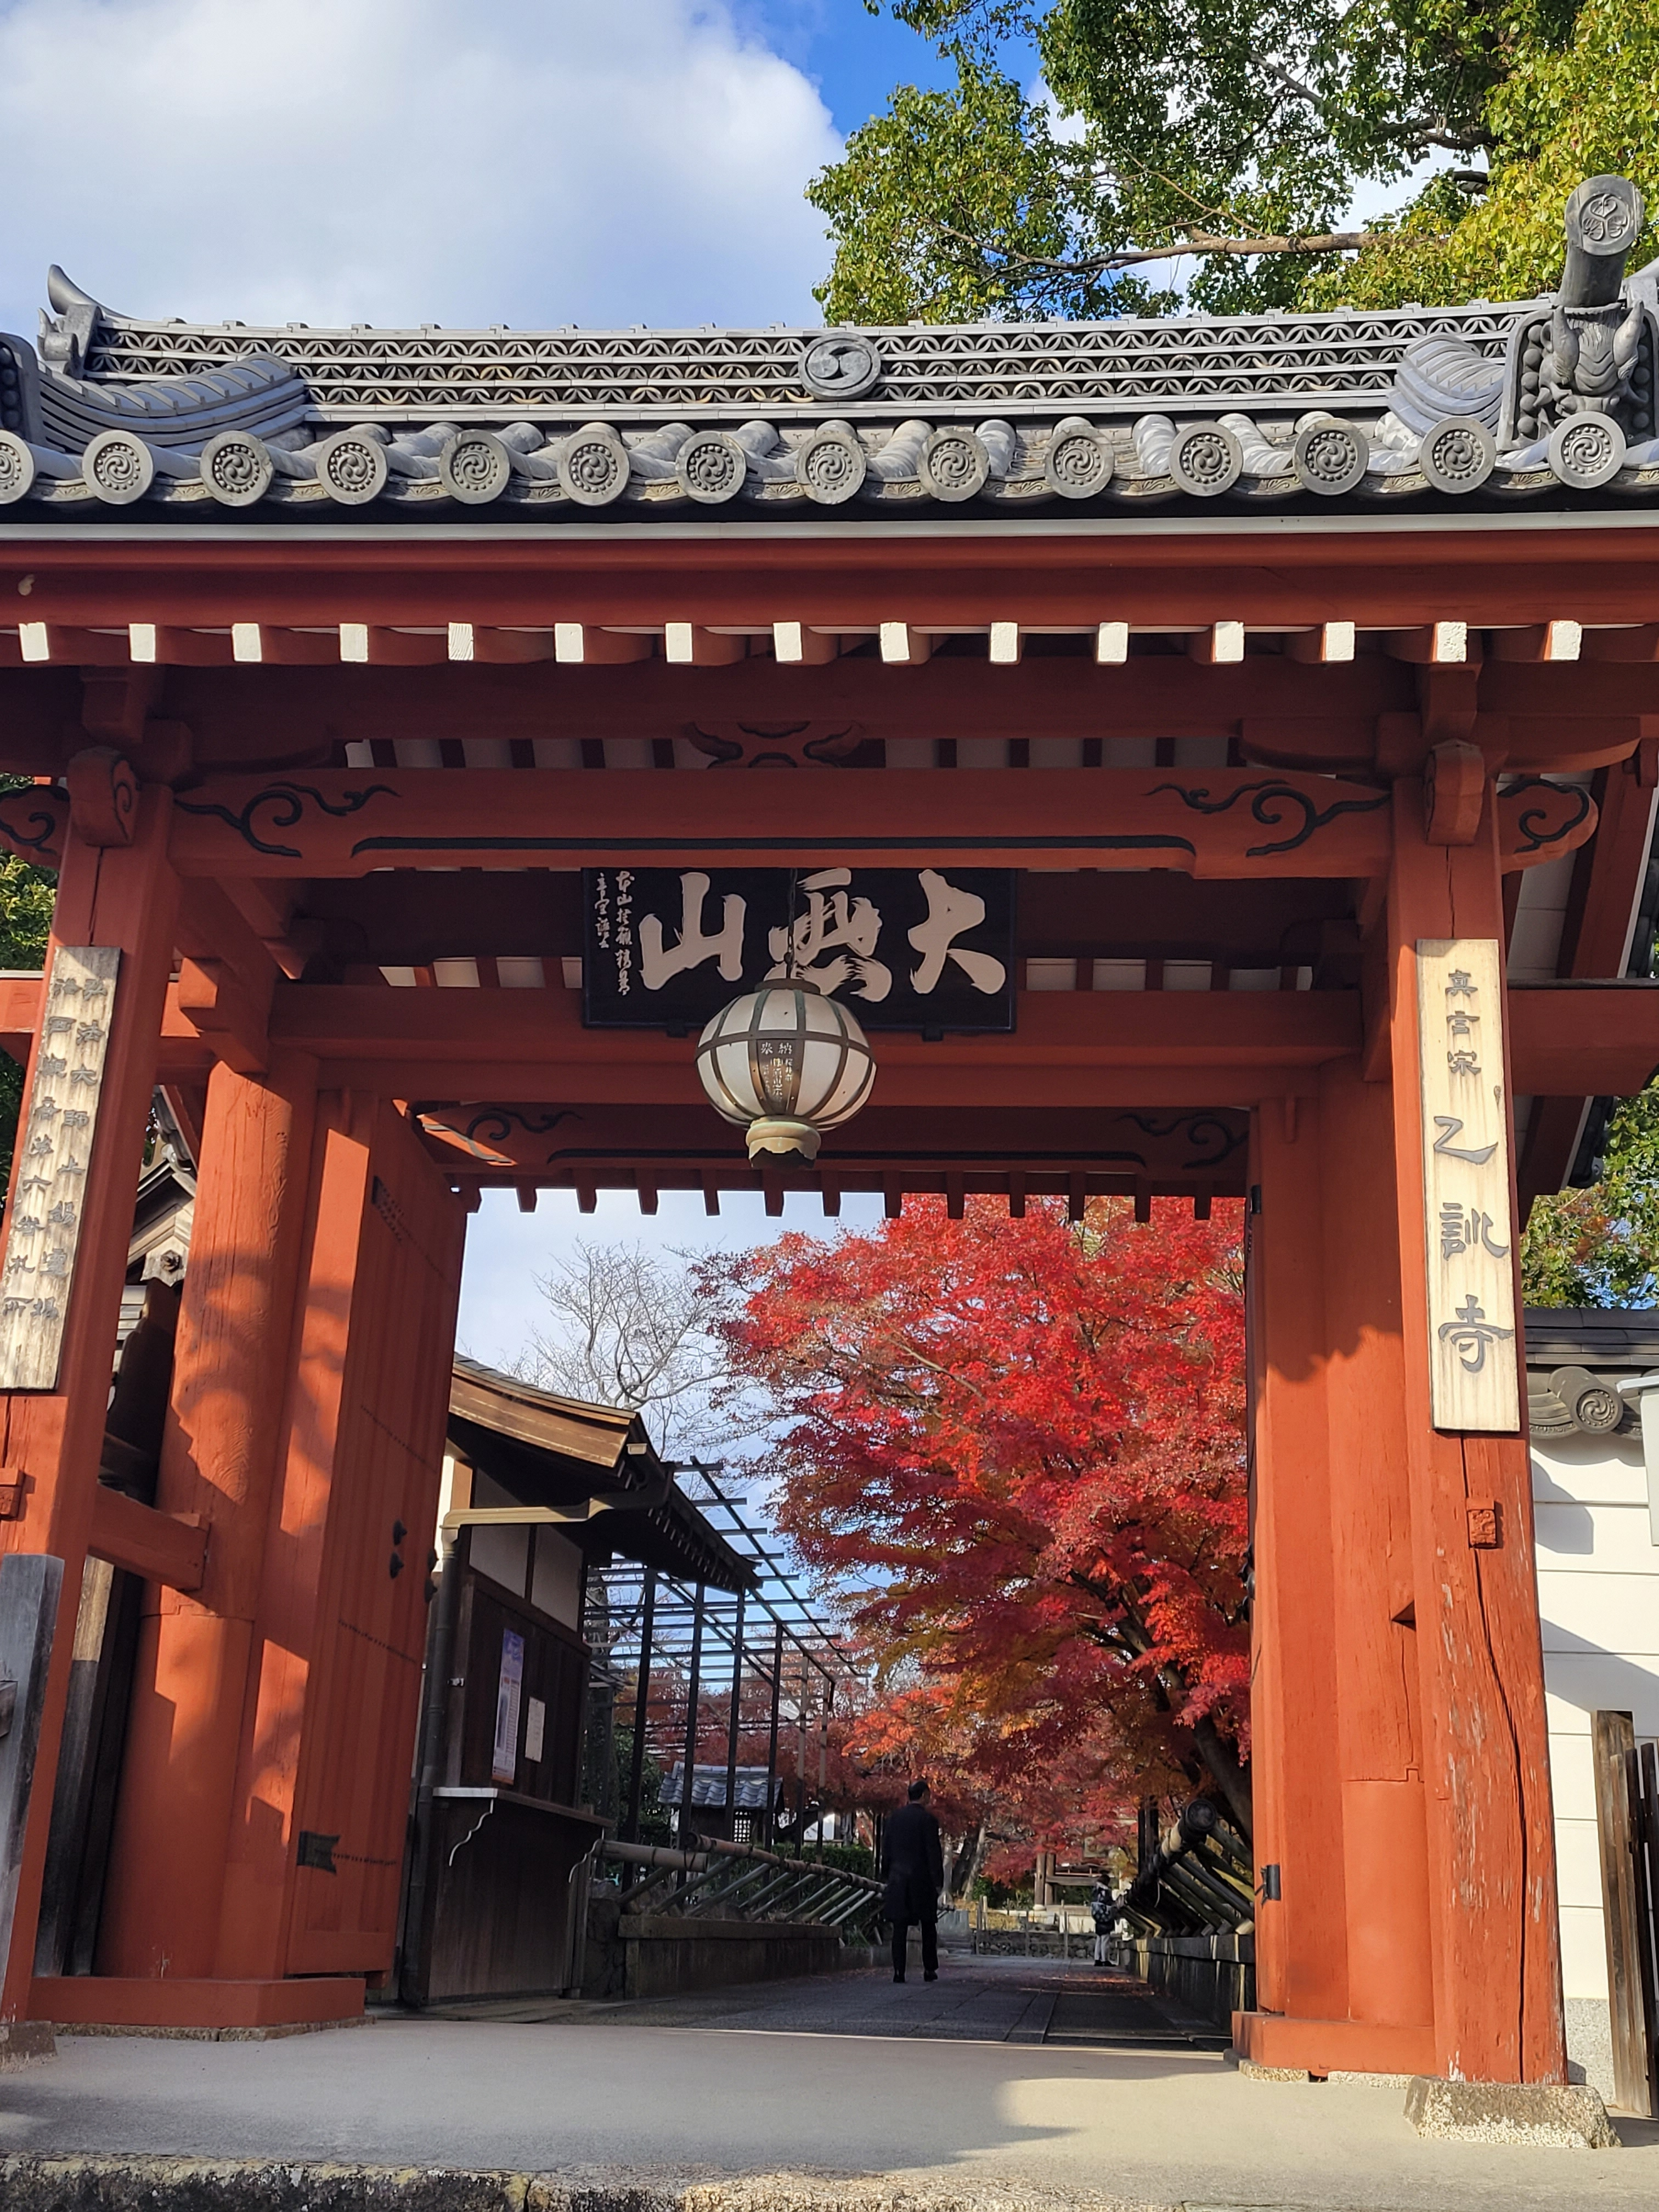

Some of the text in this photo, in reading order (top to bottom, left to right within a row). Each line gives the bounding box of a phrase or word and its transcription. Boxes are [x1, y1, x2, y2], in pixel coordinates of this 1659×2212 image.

[1432, 969, 1515, 1374] 真言宗 乙訓寺
